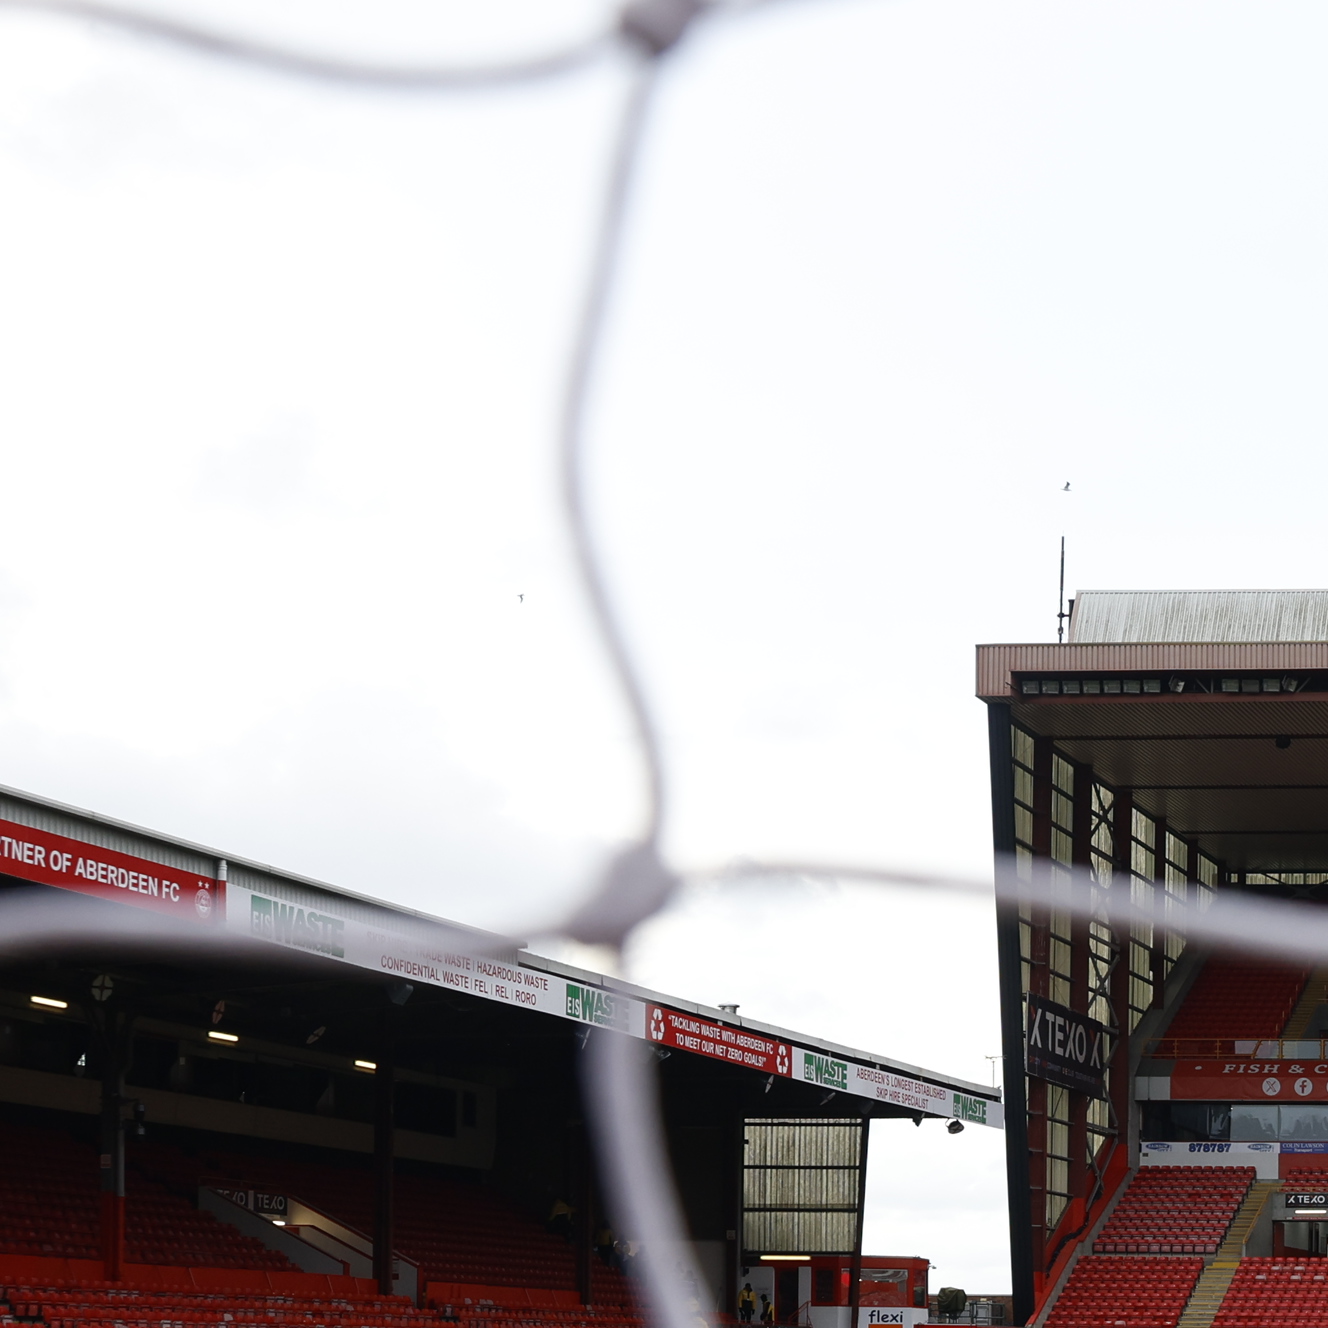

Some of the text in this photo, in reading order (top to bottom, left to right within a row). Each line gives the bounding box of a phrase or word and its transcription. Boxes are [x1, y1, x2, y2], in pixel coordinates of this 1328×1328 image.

[0, 836, 180, 902] TNER OF ABERDEEN FC
[273, 901, 344, 958] WASTE
[381, 955, 537, 1006] CONFIDENTIAL WASTE FEL REL RORO
[444, 952, 471, 970] WASTE
[477, 961, 522, 984] HAZARDOUS
[523, 974, 549, 991] WASTE
[567, 996, 580, 1015] EIS
[676, 1033, 685, 1046] TO
[685, 1035, 701, 1050] MEET
[702, 1039, 714, 1053] OUR
[715, 1043, 726, 1056] NET
[727, 1046, 742, 1060] ZERO
[701, 1023, 720, 1040] WASTE
[721, 1028, 735, 1042] WITH
[736, 1034, 765, 1052] ABERDEEN
[765, 1042, 773, 1055] FC
[1045, 1011, 1086, 1063] TEXO
[805, 1055, 847, 1090] EIS WASTE
[1222, 1064, 1281, 1075] FISH
[1288, 1063, 1305, 1074] &
[876, 1087, 929, 1110] SKIP HIRE SPECIALIST
[891, 1075, 914, 1092] LONGEST
[914, 1081, 947, 1100] ESTABLISHED
[961, 1096, 986, 1124] WASTE
[1188, 1143, 1231, 1153] 878787
[1297, 1195, 1325, 1204] TEXO
[868, 1310, 903, 1324] flexi
